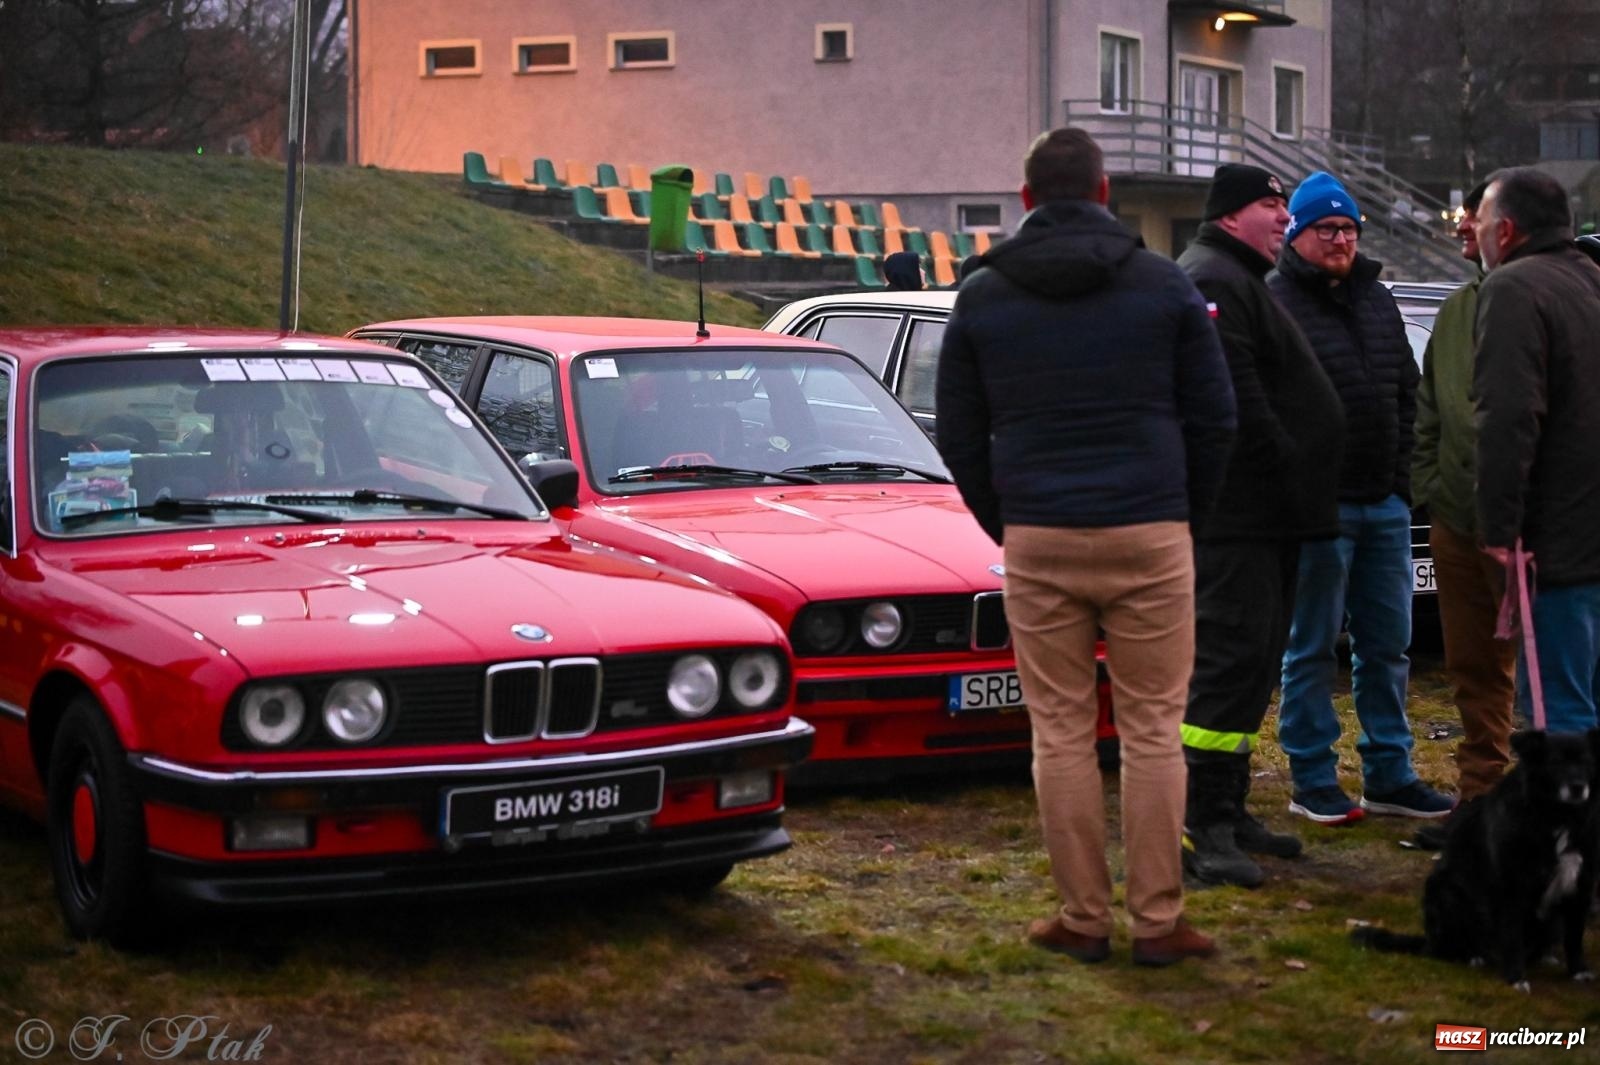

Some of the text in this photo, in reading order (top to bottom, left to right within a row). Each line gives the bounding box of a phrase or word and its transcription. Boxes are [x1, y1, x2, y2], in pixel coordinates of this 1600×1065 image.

[966, 674, 1023, 706] SRB
[494, 784, 620, 822] BMW 318i
